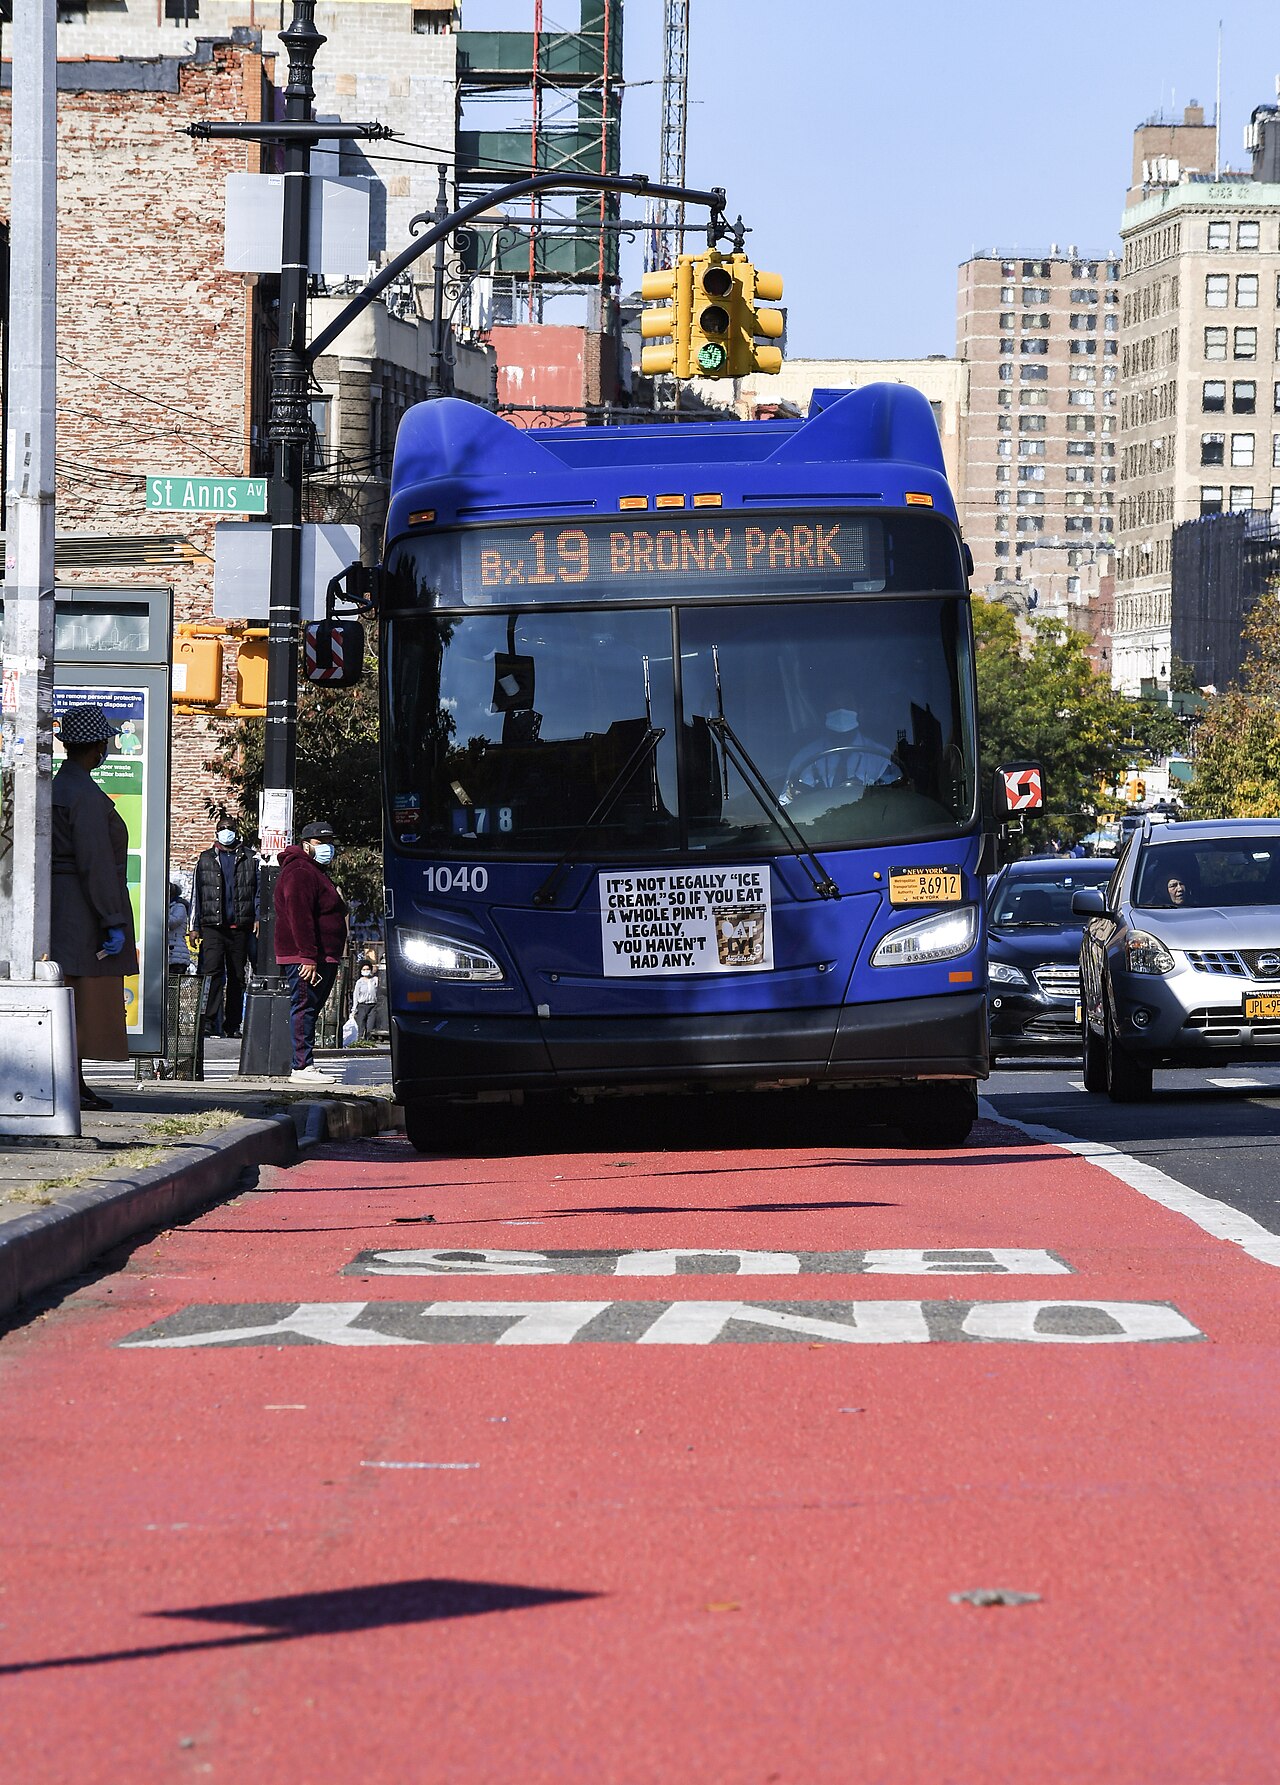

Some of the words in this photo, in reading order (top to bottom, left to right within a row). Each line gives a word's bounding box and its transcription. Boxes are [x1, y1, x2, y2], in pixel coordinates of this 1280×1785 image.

[152, 480, 173, 506] St
[183, 481, 237, 508] Anns
[247, 483, 262, 496] Av
[481, 530, 590, 586] Bx19
[609, 528, 732, 573] BRONX
[745, 523, 841, 568] PARK
[423, 866, 488, 892] 1040
[607, 878, 633, 893] IT’S
[637, 877, 666, 892] NOT
[669, 874, 726, 890] LEGALLY
[668, 892, 685, 906] SO
[690, 890, 701, 905] IF
[704, 889, 733, 904] YOU
[737, 888, 763, 902] EAT
[607, 910, 617, 924] A
[619, 908, 669, 923] WHOLE
[673, 906, 708, 921] PINT,
[625, 923, 685, 938] LEGALLY,
[613, 940, 642, 954] YOU
[646, 937, 706, 953] HAVEN’T
[630, 955, 658, 969] HAD
[662, 953, 695, 968] ANY.
[366, 1248, 1071, 1276] BUS
[118, 1300, 1201, 1347] ONLY
